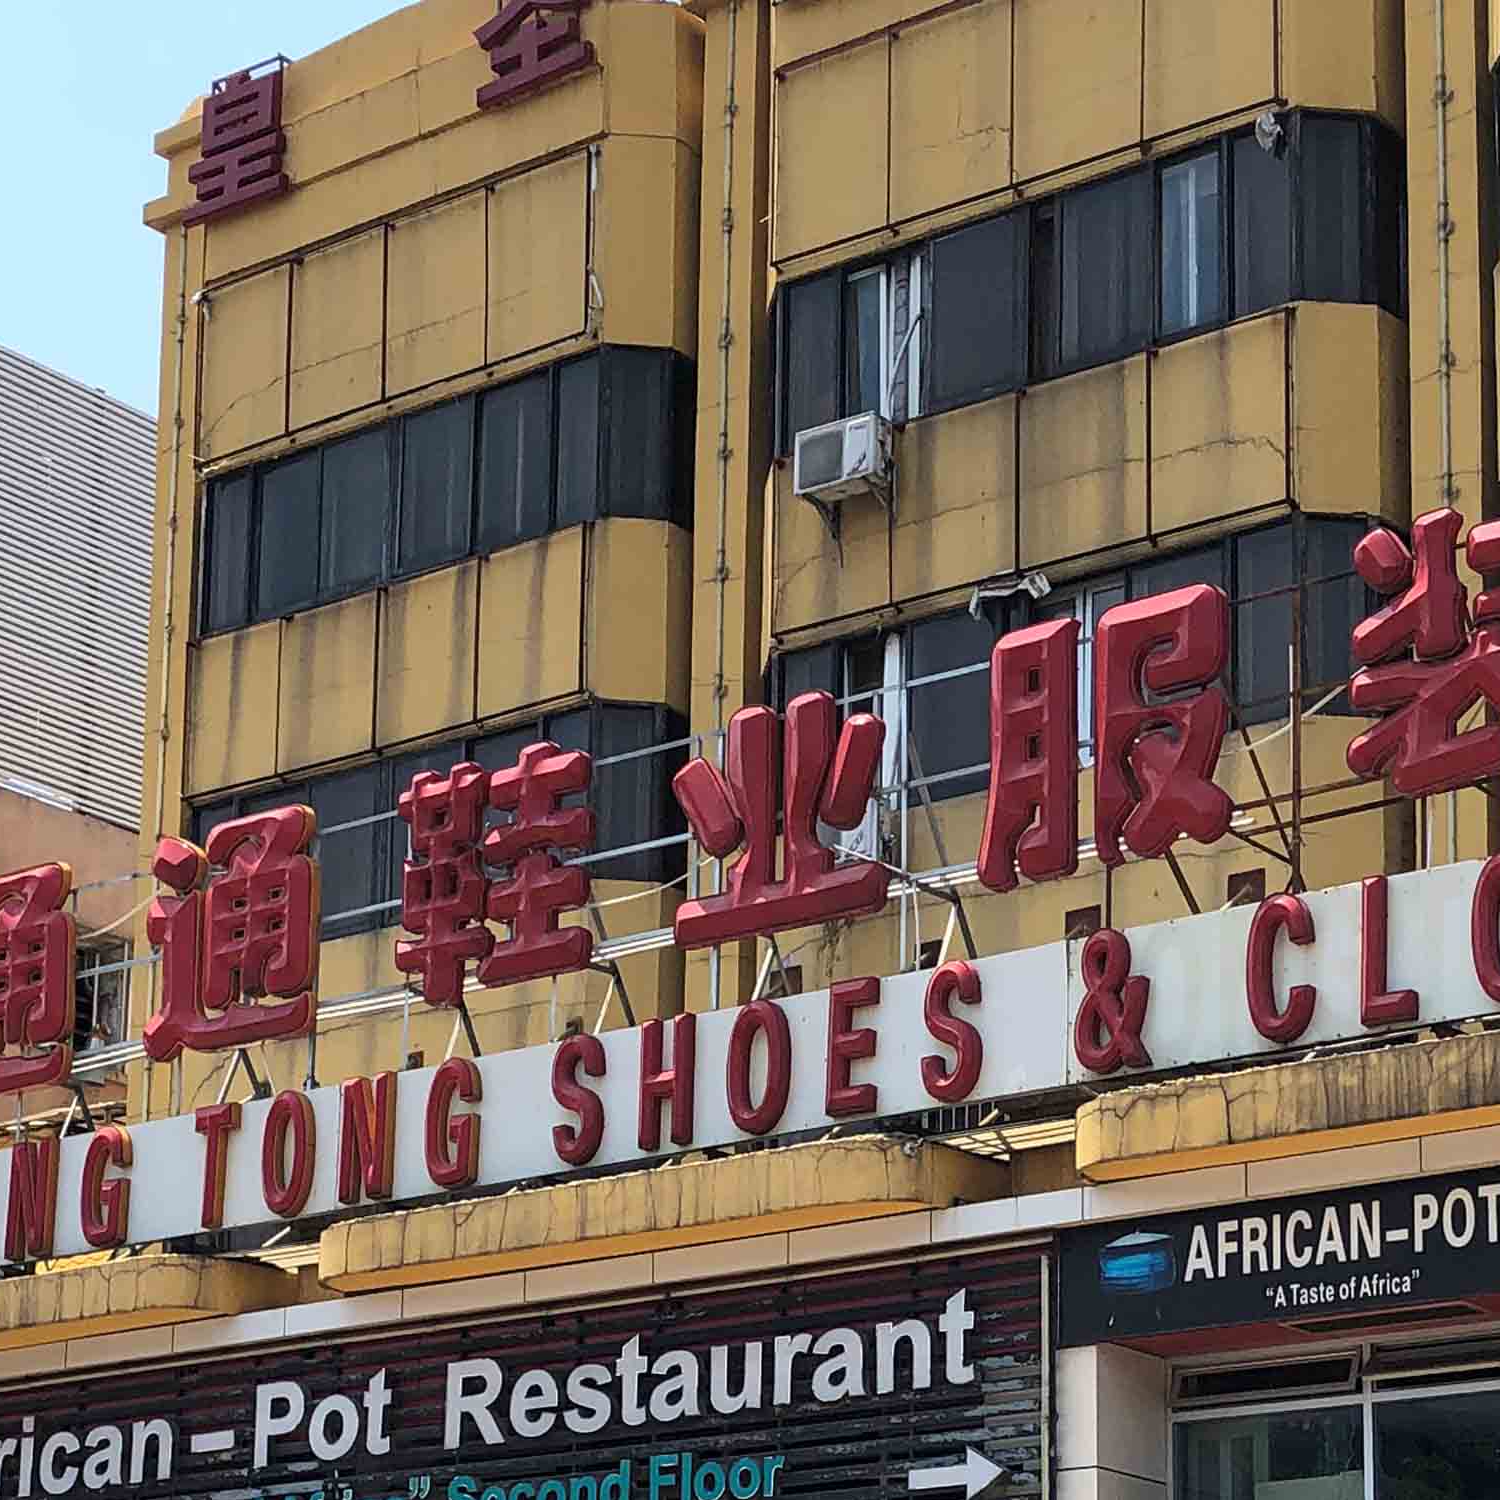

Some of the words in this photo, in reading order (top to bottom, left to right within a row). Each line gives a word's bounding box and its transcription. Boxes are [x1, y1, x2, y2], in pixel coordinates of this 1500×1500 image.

[195, 1058, 484, 1230] TONG
[551, 961, 982, 1166] SHOES
[1074, 929, 1155, 1075] &
[253, 1367, 392, 1469] Pot
[444, 1287, 977, 1450] Restaurant
[1290, 1281, 1334, 1306] Taste
[1339, 1279, 1356, 1300] of
